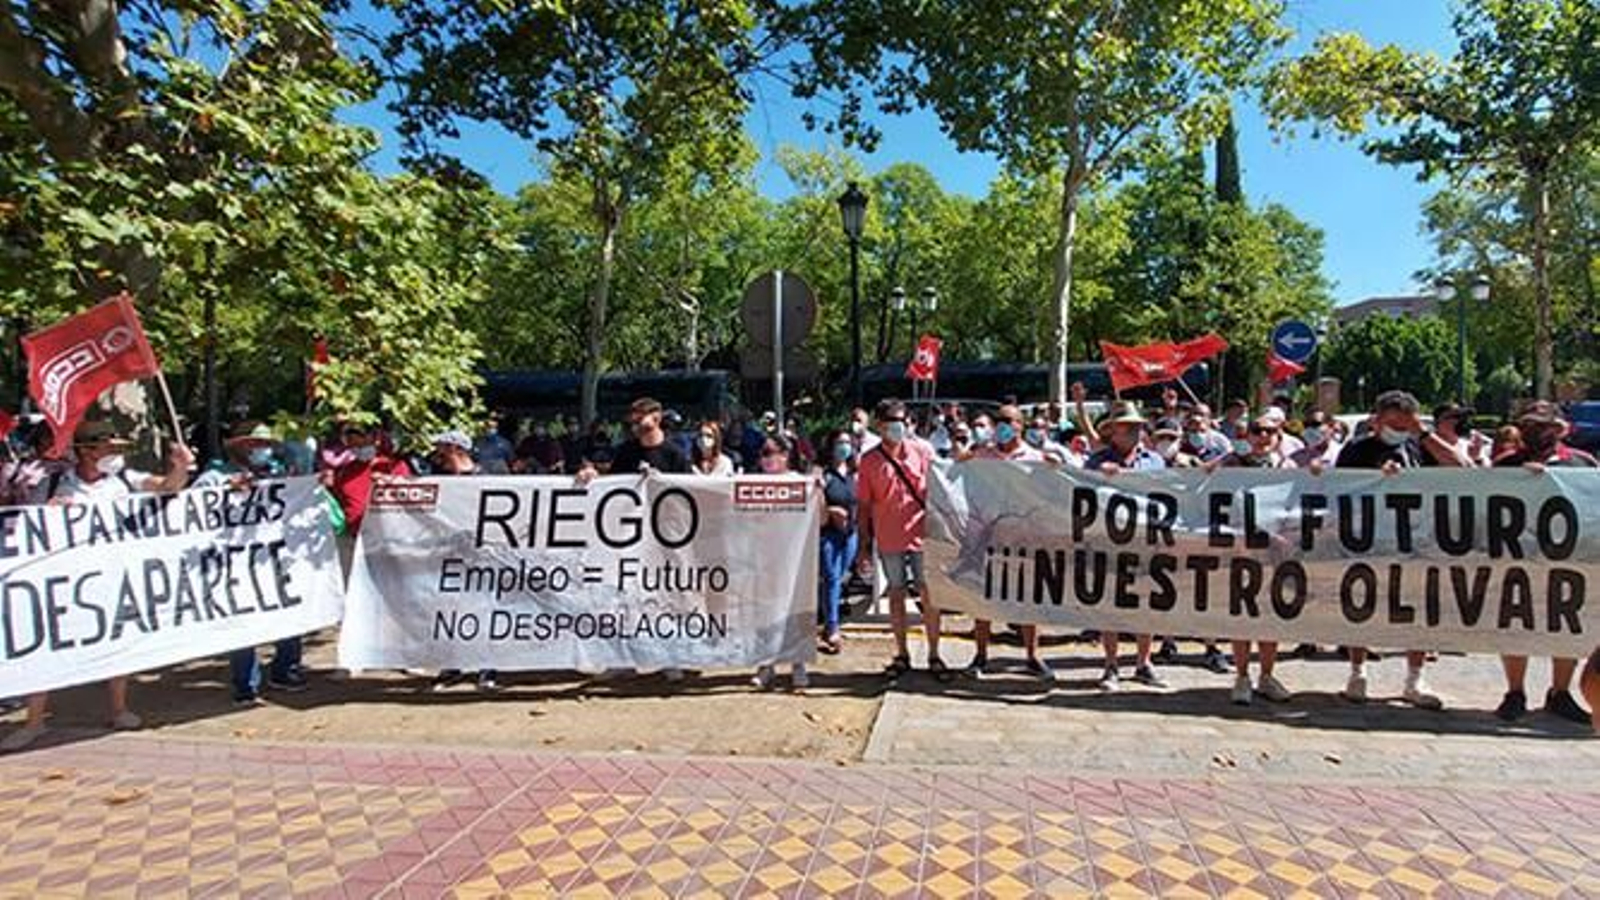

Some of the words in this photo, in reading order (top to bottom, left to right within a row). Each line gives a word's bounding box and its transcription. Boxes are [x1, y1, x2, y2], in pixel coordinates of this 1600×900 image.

[475, 487, 699, 549] RIEGO
[1071, 486, 1178, 546] POR
[1208, 491, 1270, 549] EL
[1300, 494, 1579, 560] FUTURO
[2, 539, 302, 660] DESAPARECE
[439, 557, 570, 601] Empleo
[617, 557, 729, 592] Futuro
[1340, 562, 1586, 634] OLIVAR
[433, 610, 480, 641] NO
[489, 606, 728, 641] DESPOBLACIÓN
